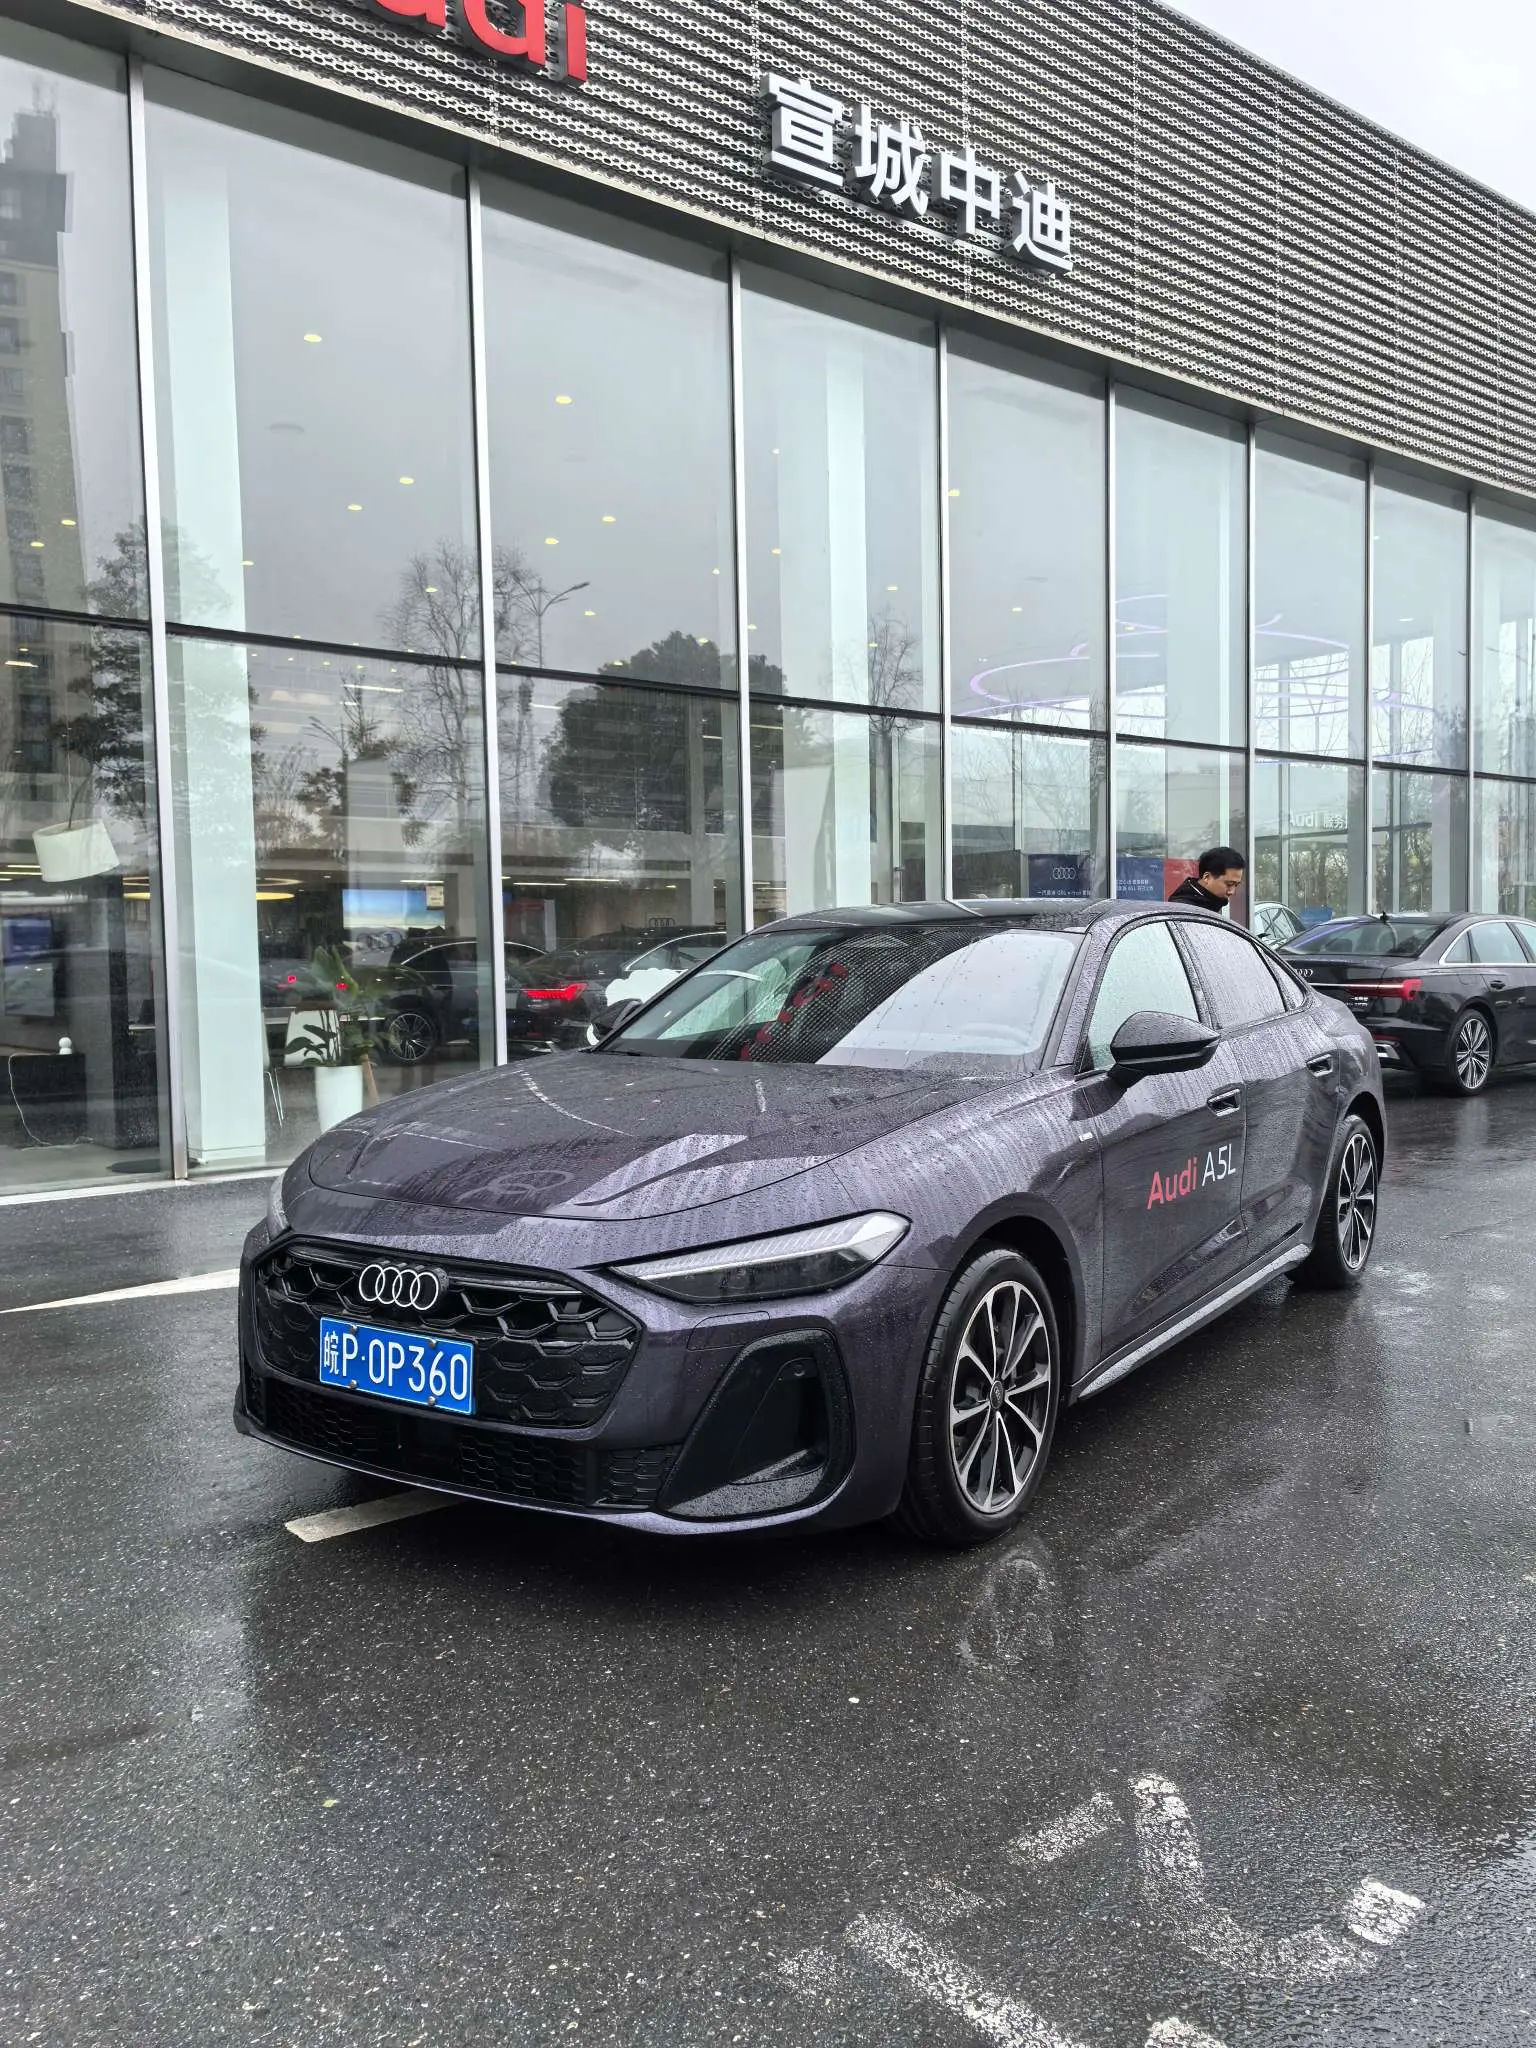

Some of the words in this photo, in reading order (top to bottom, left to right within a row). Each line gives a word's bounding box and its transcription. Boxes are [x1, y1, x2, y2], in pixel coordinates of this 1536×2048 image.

[761, 73, 1073, 271] 宣城中迪
[1147, 1156, 1197, 1210] Audi
[1201, 1143, 1237, 1187] A5L
[323, 1330, 468, 1400] 皖P·0P360
